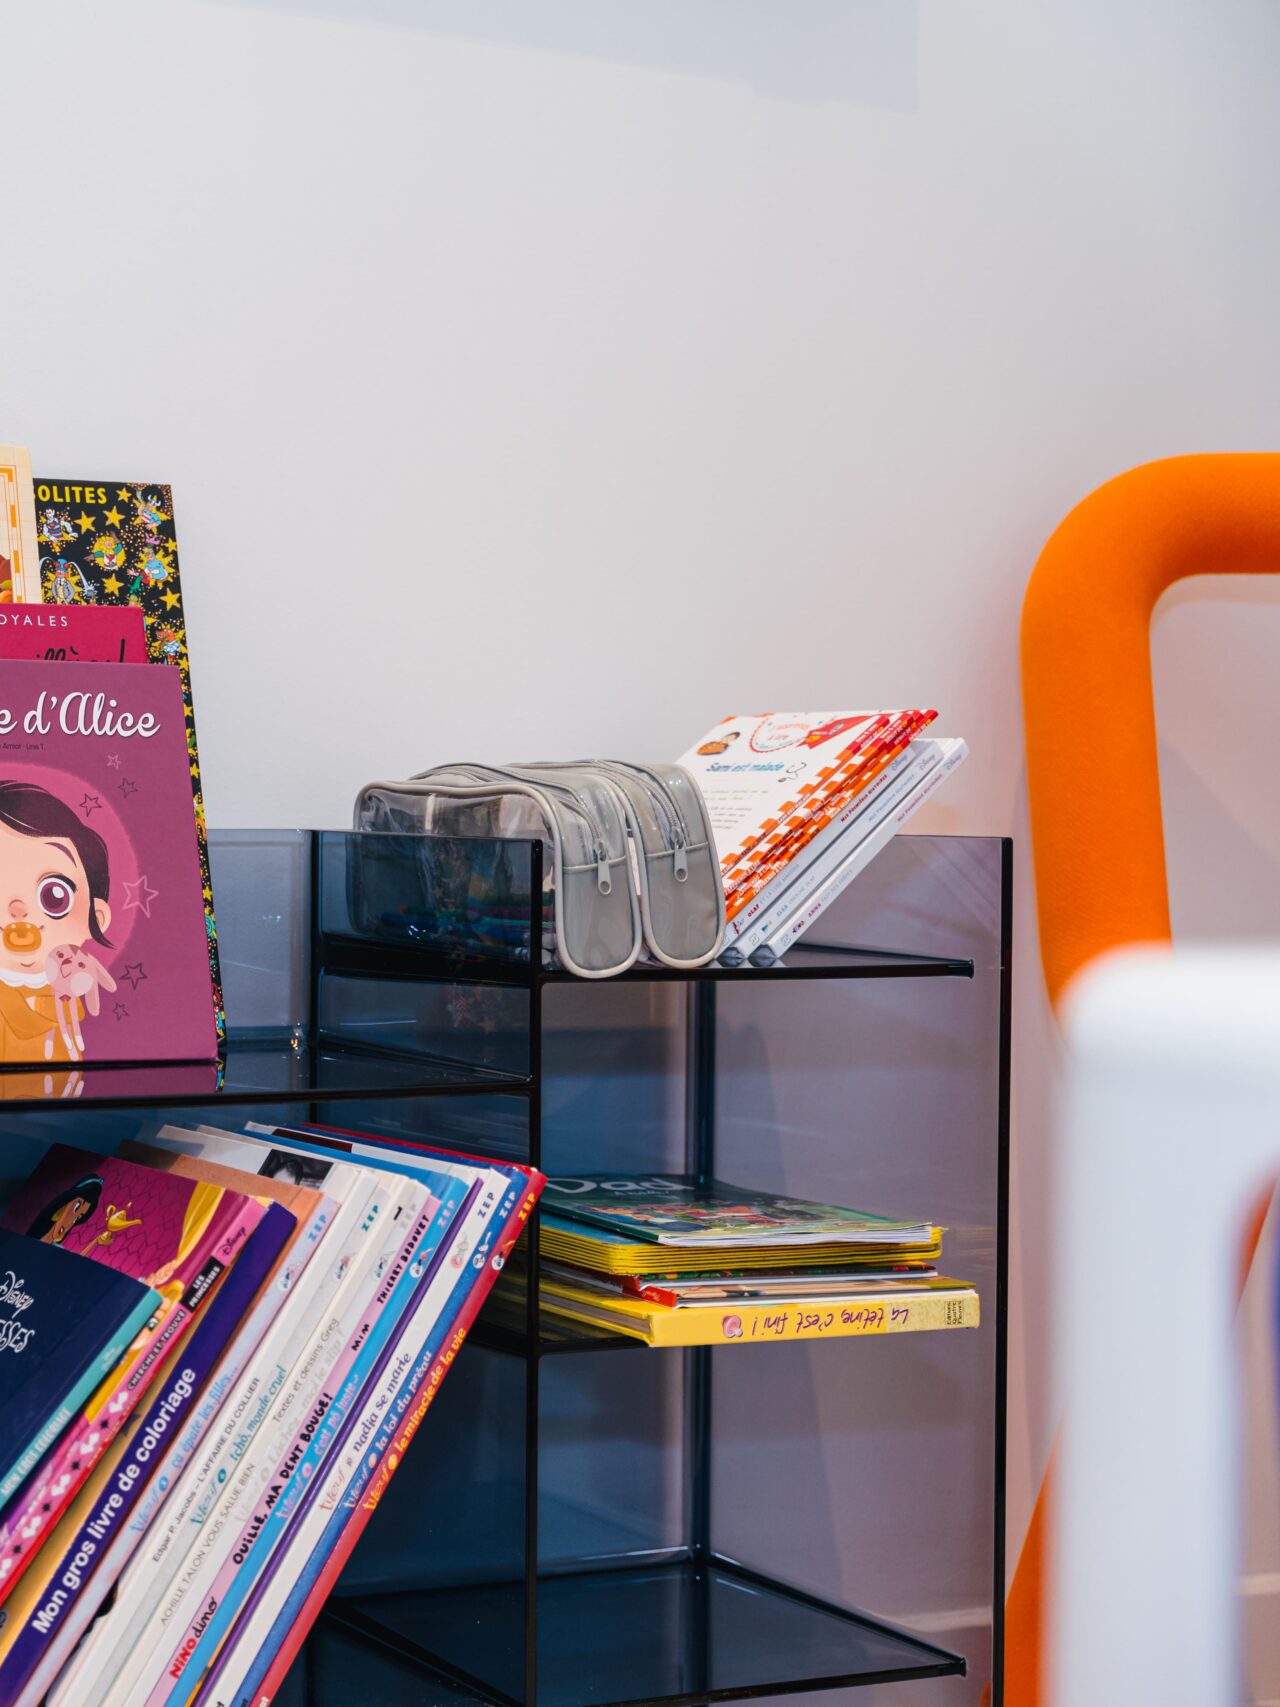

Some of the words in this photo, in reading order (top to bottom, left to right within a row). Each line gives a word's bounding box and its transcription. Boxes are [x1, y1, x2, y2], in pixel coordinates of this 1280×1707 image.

[33, 484, 107, 504] OLITES
[23, 690, 161, 737] d'Alice
[360, 1203, 380, 1232] ZEP
[436, 1198, 458, 1228] ZEP
[476, 1191, 496, 1218] ZEP
[497, 1190, 518, 1218] ZEP
[516, 1191, 538, 1221] ZEP
[215, 1222, 248, 1260] Disney
[305, 1212, 329, 1243] ZEP
[188, 1265, 221, 1307] PRINCESSES
[191, 1273, 206, 1289] LES
[762, 1311, 789, 1335] fini
[795, 1309, 834, 1332] c'est
[839, 1307, 884, 1330] tétine
[889, 1307, 909, 1324] La
[448, 1325, 468, 1350] vie
[271, 1390, 296, 1424] Textes
[290, 1379, 302, 1392] et
[297, 1342, 324, 1380] dessins
[318, 1316, 340, 1344] Greg
[437, 1347, 455, 1366] la
[426, 1363, 446, 1387] de
[196, 1400, 215, 1421] les
[241, 1391, 273, 1433] monde
[262, 1363, 289, 1396] cruel
[348, 1409, 380, 1453] nadia
[372, 1392, 390, 1412] se
[381, 1350, 413, 1393] marie
[373, 1433, 389, 1451] la
[381, 1413, 400, 1435] loi
[392, 1390, 412, 1414] du
[404, 1348, 436, 1394] préau
[400, 1383, 438, 1439] miracle
[392, 1434, 409, 1453] le
[150, 1533, 173, 1563] Edgar
[173, 1488, 197, 1523] Jacobs
[195, 1433, 228, 1483] L'AFFAIRE
[223, 1418, 237, 1435] DU
[232, 1376, 261, 1420] COLLIER
[260, 1480, 284, 1509] MA
[278, 1442, 306, 1480] DENT
[30, 1585, 69, 1634] Mon
[58, 1537, 102, 1591] gros
[85, 1489, 125, 1540] livre
[112, 1459, 142, 1494] de
[129, 1364, 201, 1466] coloriage
[157, 1584, 187, 1626] ACHILLE
[180, 1548, 206, 1585] TALON
[200, 1518, 224, 1550] VOUS
[218, 1484, 242, 1519] SALUE
[236, 1461, 256, 1486] BIEN
